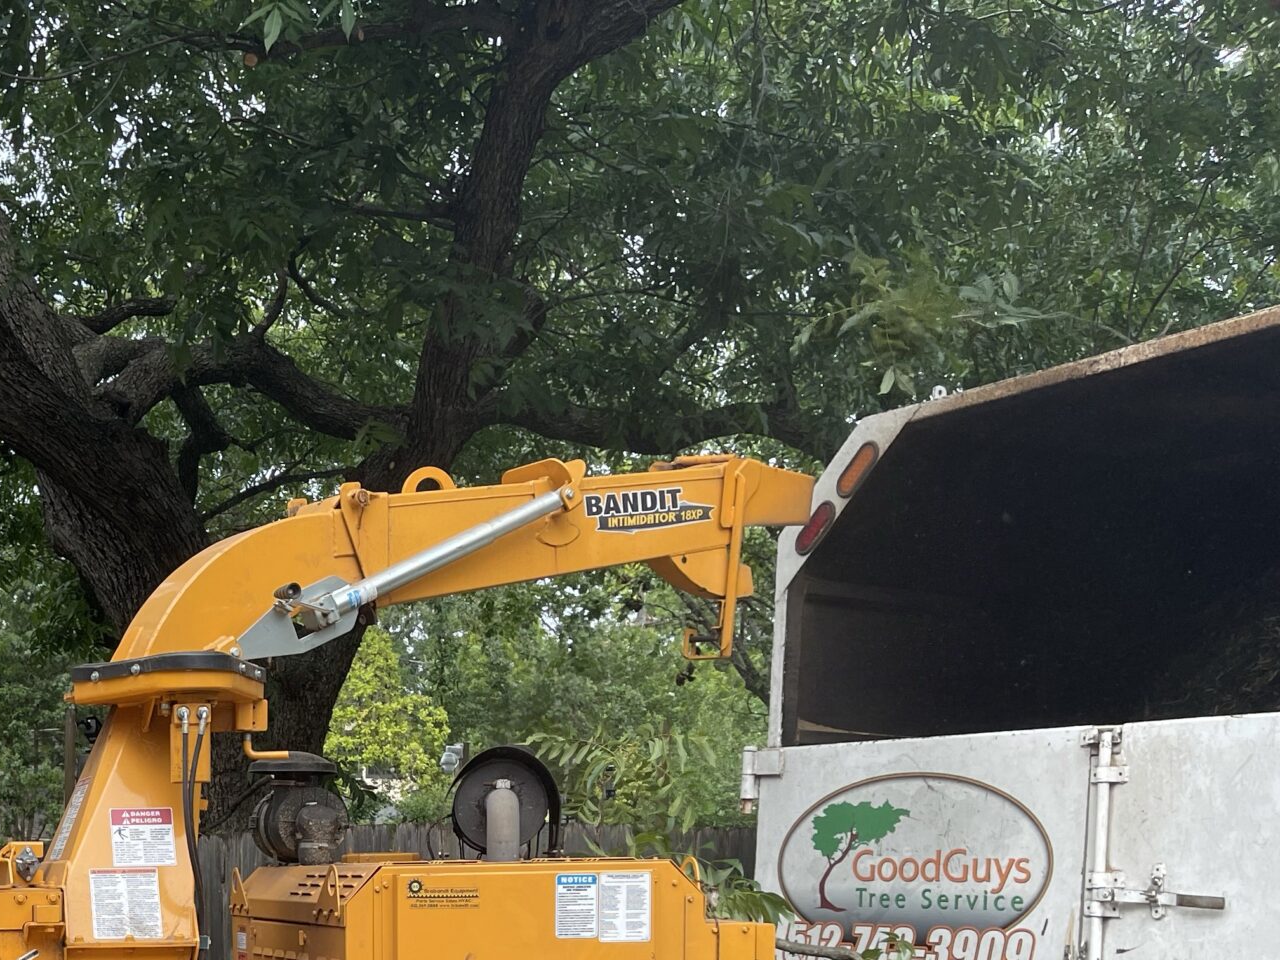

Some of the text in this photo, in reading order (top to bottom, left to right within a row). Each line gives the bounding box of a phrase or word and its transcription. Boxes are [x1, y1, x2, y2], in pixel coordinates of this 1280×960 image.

[586, 488, 681, 516] BANDIT
[680, 509, 703, 521] 18XP
[852, 849, 1032, 894] GoodGuys
[856, 888, 1024, 912] Tree Service
